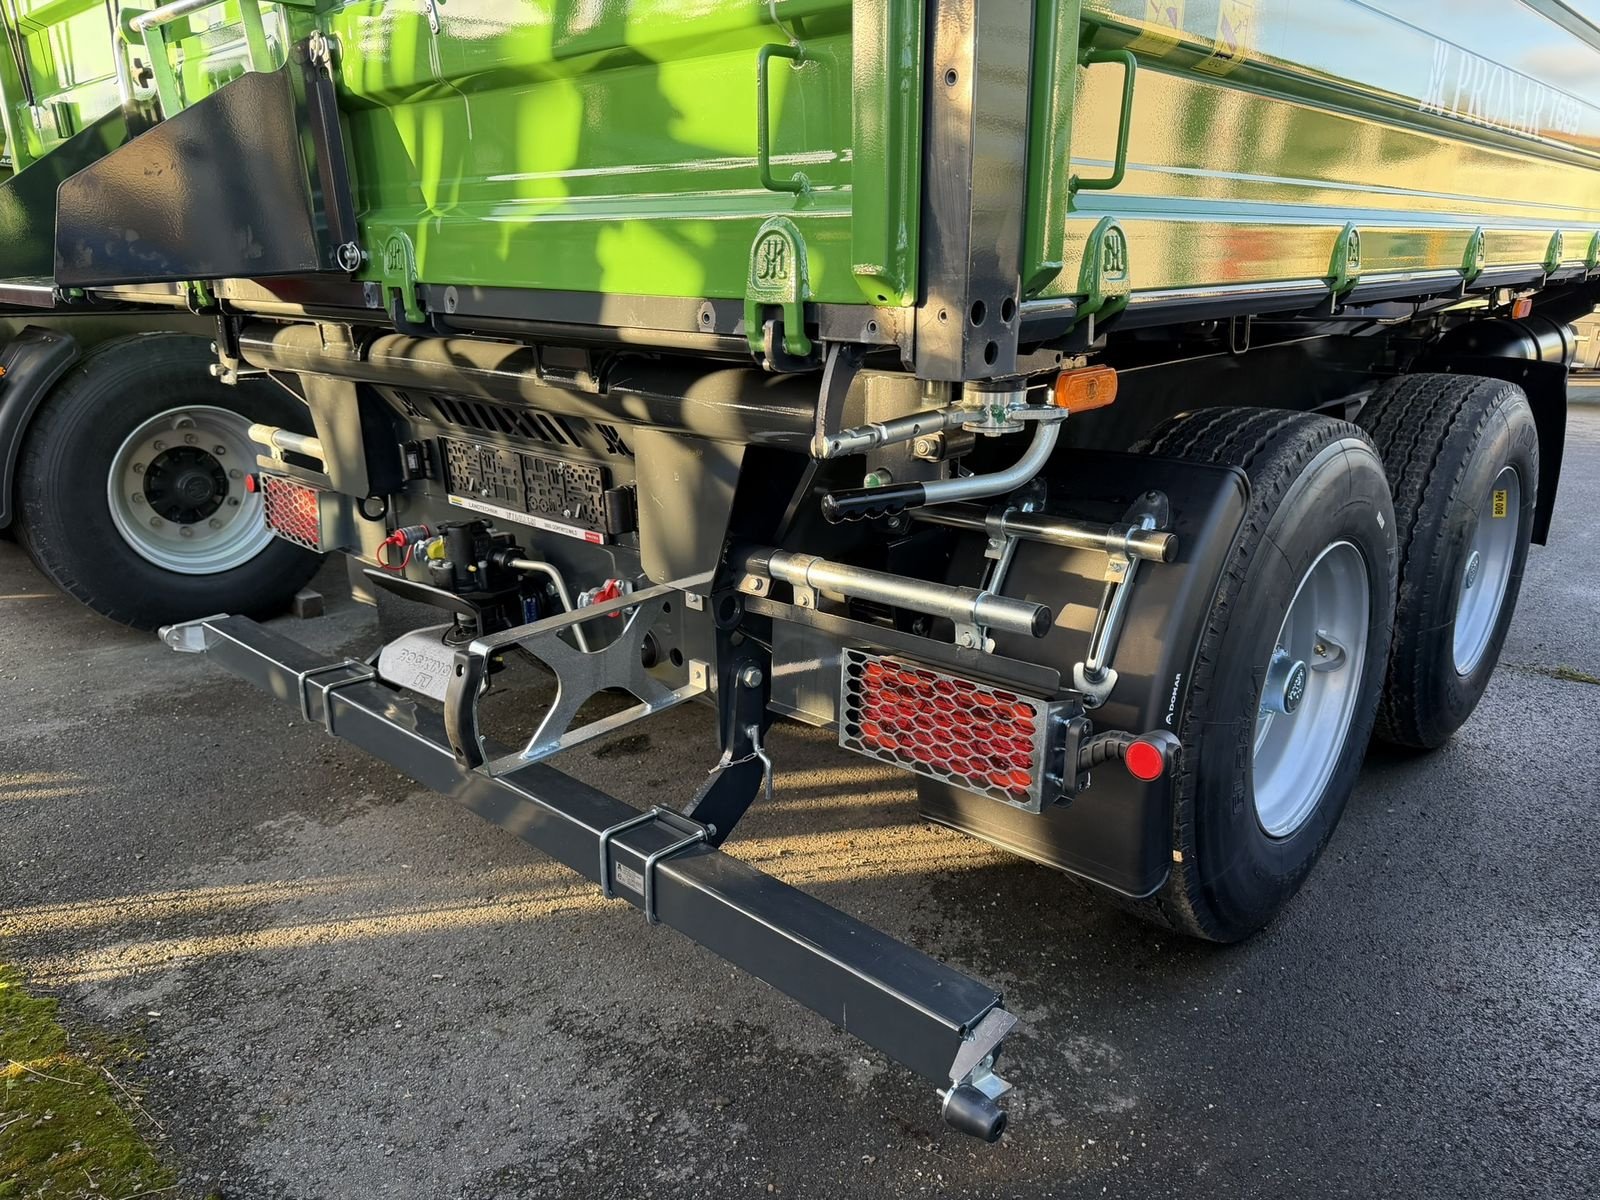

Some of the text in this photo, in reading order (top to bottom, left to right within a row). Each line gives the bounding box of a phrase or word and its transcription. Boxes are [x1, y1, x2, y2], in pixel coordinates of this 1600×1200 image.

[1449, 51, 1546, 136] PRONAR
[1495, 502, 1504, 515] 800
[397, 648, 452, 677] ROCKING
[1169, 673, 1181, 711] DOMAR
